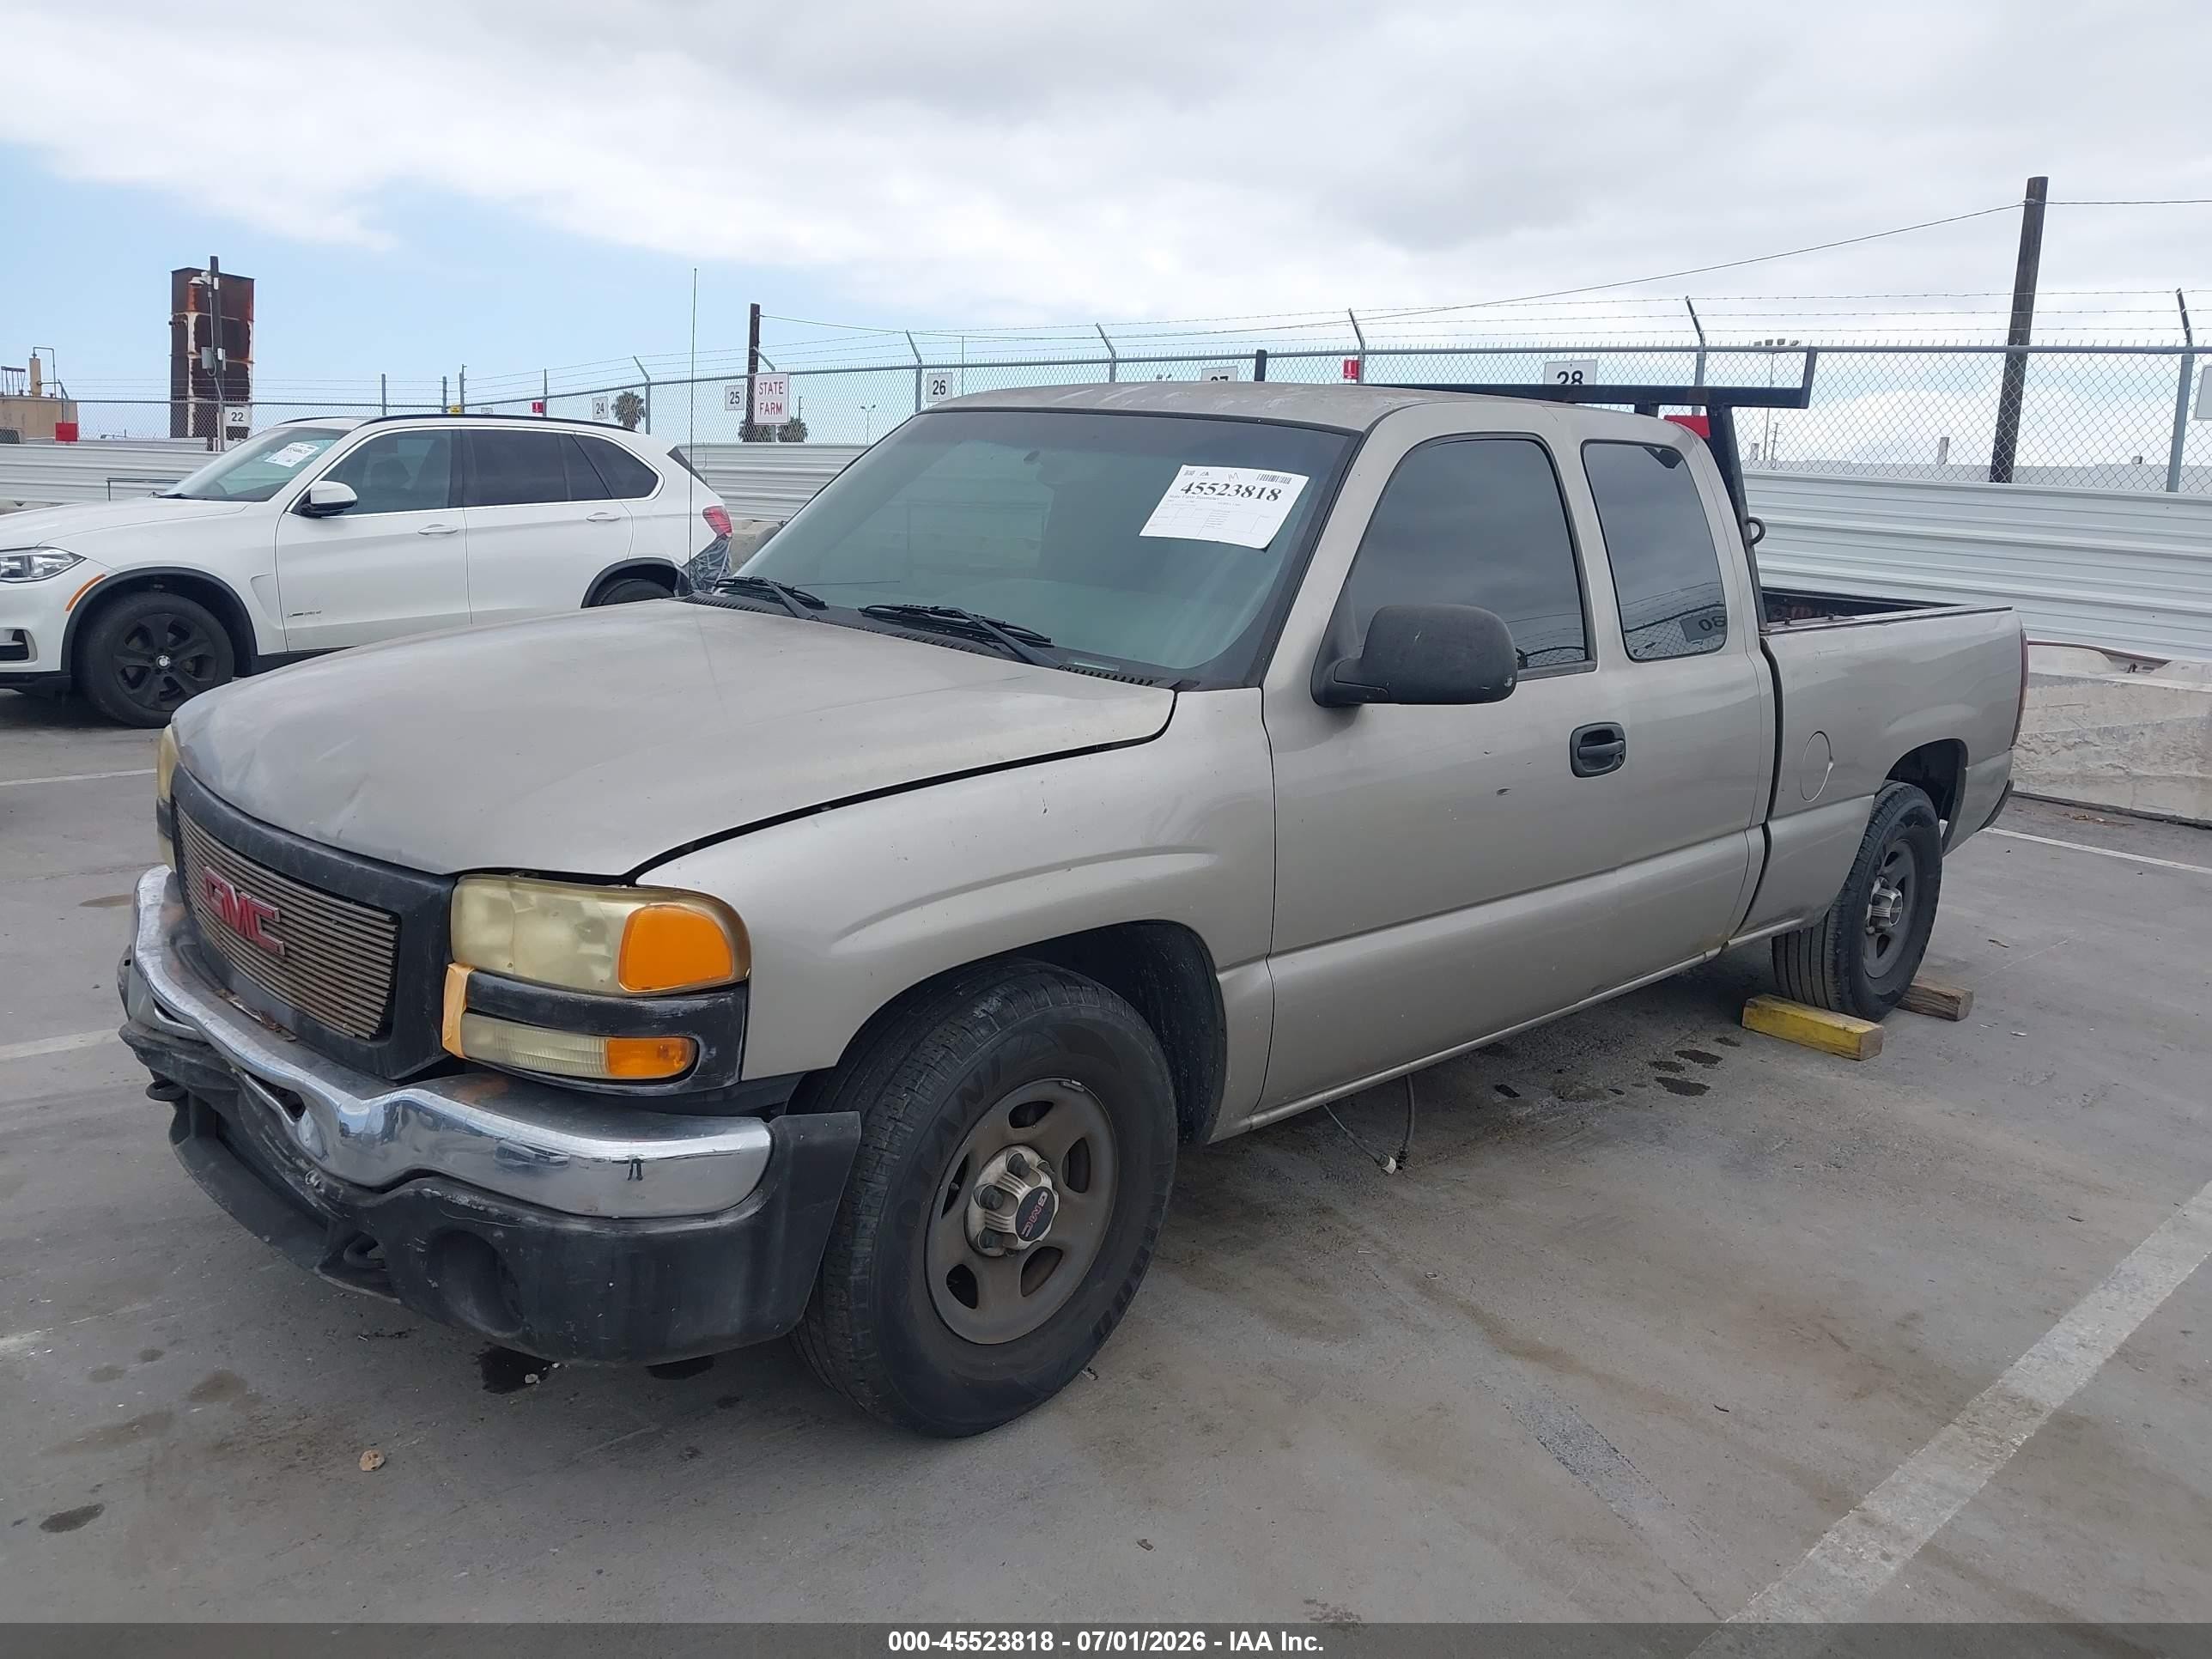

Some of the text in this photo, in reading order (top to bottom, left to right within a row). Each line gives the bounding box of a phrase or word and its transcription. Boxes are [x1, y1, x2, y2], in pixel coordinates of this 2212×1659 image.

[758, 381, 784, 395] STATE
[933, 380, 946, 395] 26
[729, 391, 740, 404] 25
[596, 402, 605, 414] 24
[759, 402, 782, 416] FARM
[231, 411, 244, 422] 22
[1180, 481, 1282, 501] 45523818
[203, 865, 286, 957] GMC
[1020, 1191, 1048, 1237] GMC
